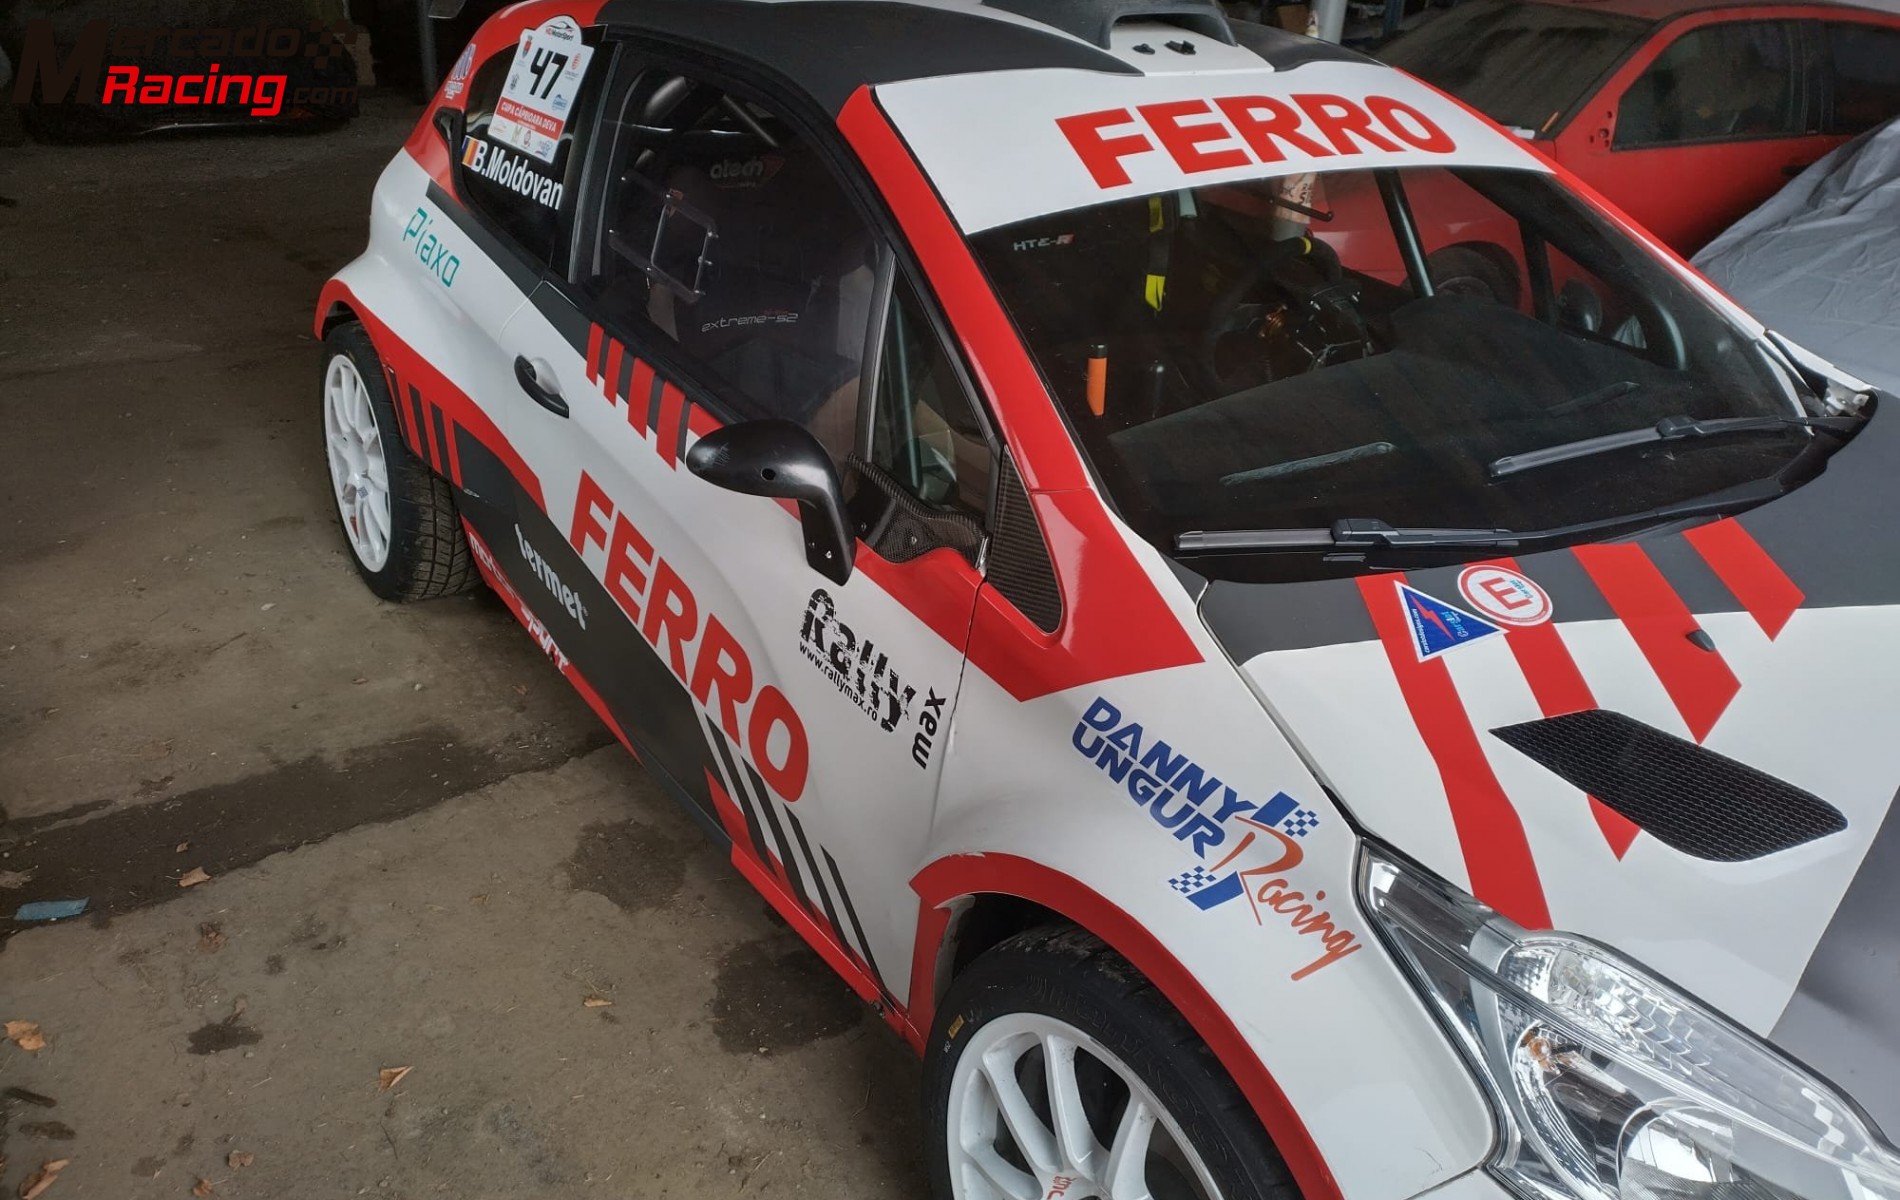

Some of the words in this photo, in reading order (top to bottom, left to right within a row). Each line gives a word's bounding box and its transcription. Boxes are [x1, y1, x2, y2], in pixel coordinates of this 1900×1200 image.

[530, 47, 569, 100] 47
[1055, 93, 1456, 190] FERRO
[402, 207, 461, 288] Piaxo
[514, 523, 586, 631] termet
[569, 469, 810, 804] FERRO
[799, 641, 878, 722] www.rallymax.ro
[911, 686, 947, 770] max
[1081, 695, 1260, 824] DANNY
[1071, 720, 1226, 861] UNGUR
[1209, 815, 1362, 981] Racing
